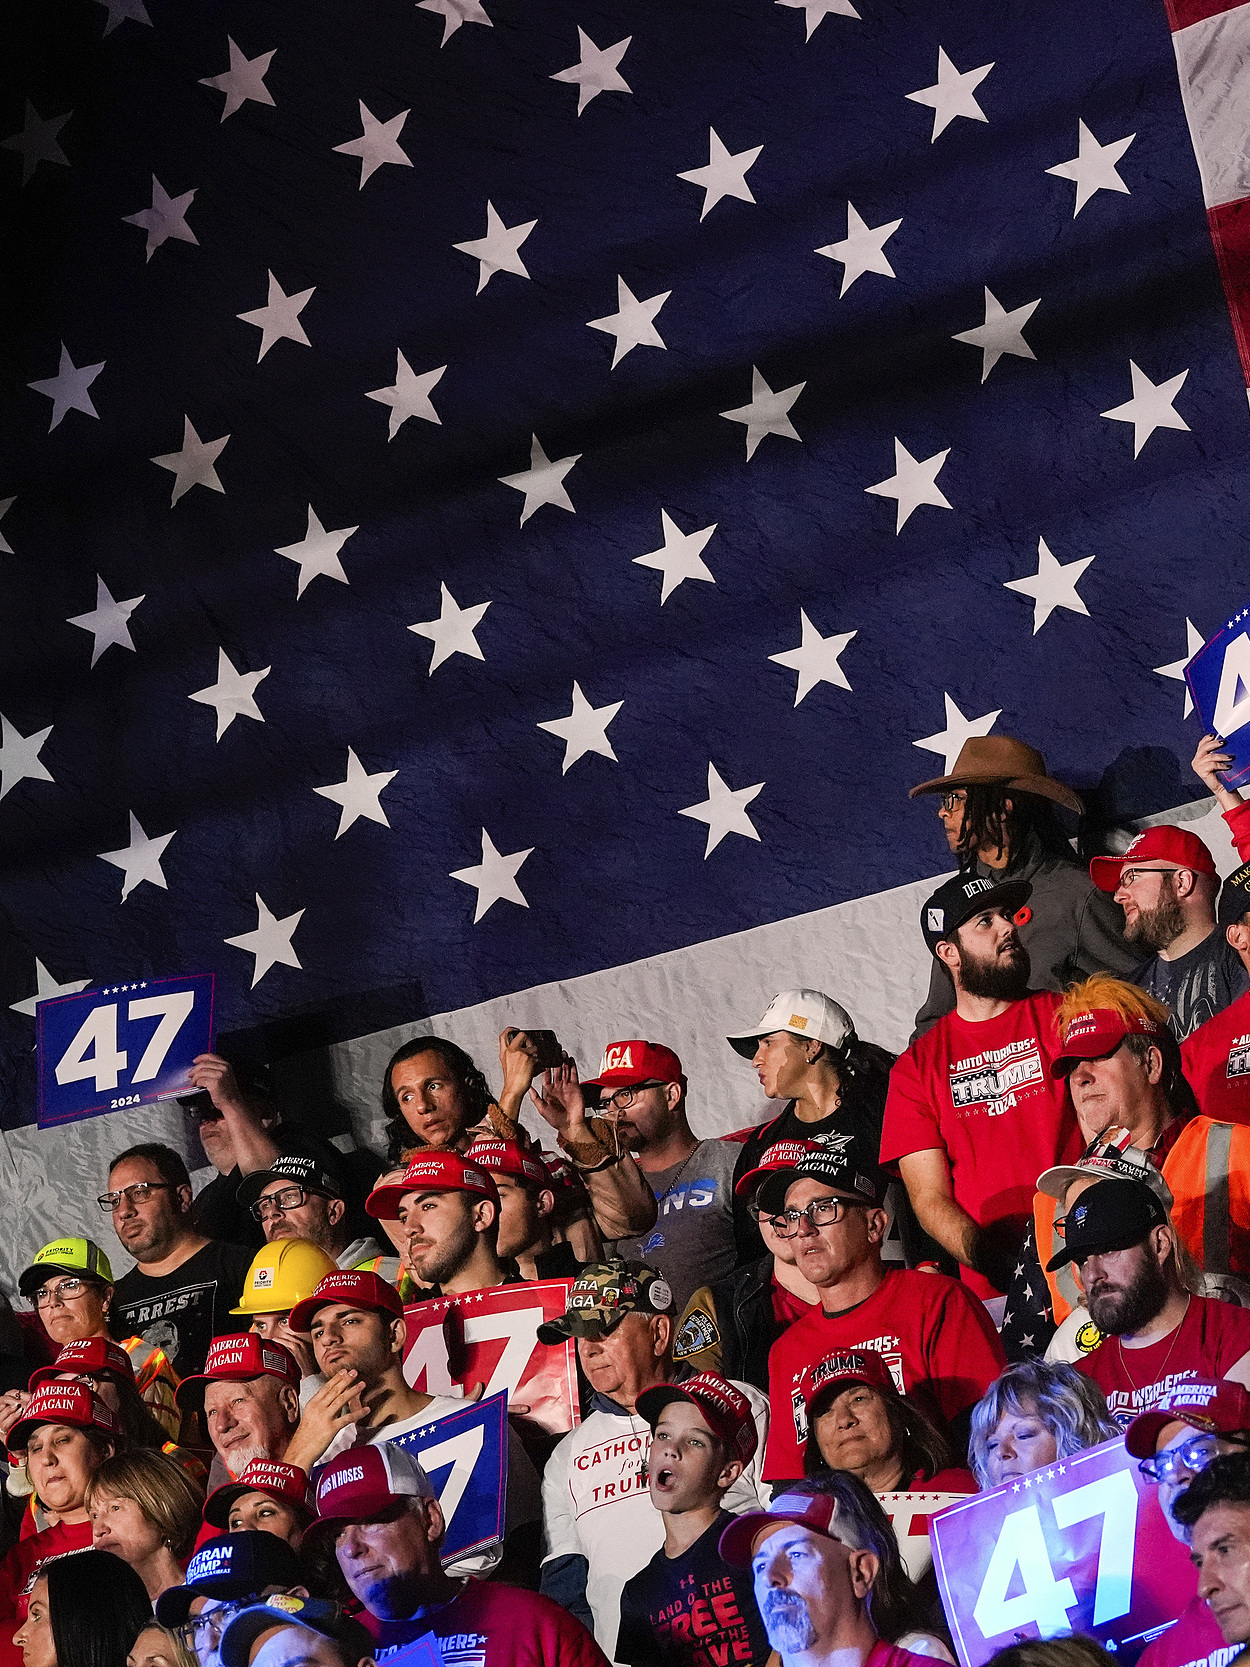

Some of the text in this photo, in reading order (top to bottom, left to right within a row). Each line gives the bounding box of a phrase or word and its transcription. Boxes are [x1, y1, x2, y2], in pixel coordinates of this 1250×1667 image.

[55, 990, 195, 1092] 47
[957, 1039, 1030, 1072] AUTO WORKERS
[954, 1058, 1040, 1102] TRUMP
[110, 1094, 141, 1109] 2024
[988, 1093, 1017, 1117] 2024
[468, 1142, 507, 1156] AMERICA
[773, 1143, 806, 1153] AMERICA
[777, 1151, 801, 1160] AGAIN
[272, 1156, 316, 1170] AMERICA
[410, 1161, 445, 1173] AMERICA
[799, 1152, 848, 1167] AMERICA
[277, 1167, 308, 1178] AGAIN
[414, 1168, 438, 1177] AGAIN
[802, 1162, 839, 1176] AGAIN
[1117, 1160, 1149, 1177] TRUMP
[46, 1247, 74, 1256] PRIORITY
[324, 1275, 361, 1285] AMERICA
[700, 1314, 714, 1333] POLICE
[210, 1338, 250, 1352] AMERICA
[688, 1344, 704, 1353] YORK
[212, 1352, 243, 1368] AGAIN
[402, 1307, 544, 1401] 47
[811, 1355, 866, 1384] TRUMP
[37, 1386, 82, 1399] AMERICA
[696, 1373, 743, 1410] AMERICA
[1170, 1384, 1218, 1397] AMERICA
[41, 1399, 74, 1411] AGAIN
[698, 1387, 730, 1414] AGAIN
[1173, 1395, 1211, 1406] AGAIN
[244, 1462, 295, 1479] AMERICA
[331, 1473, 338, 1489] N
[337, 1466, 364, 1487] HOSES
[418, 1424, 484, 1532] 7
[250, 1474, 287, 1490] AGAIN
[592, 1474, 651, 1502] TRUM
[973, 1468, 1139, 1640] 47
[650, 1600, 682, 1626] LAND
[702, 1576, 733, 1596] THE
[718, 1625, 750, 1641] THE
